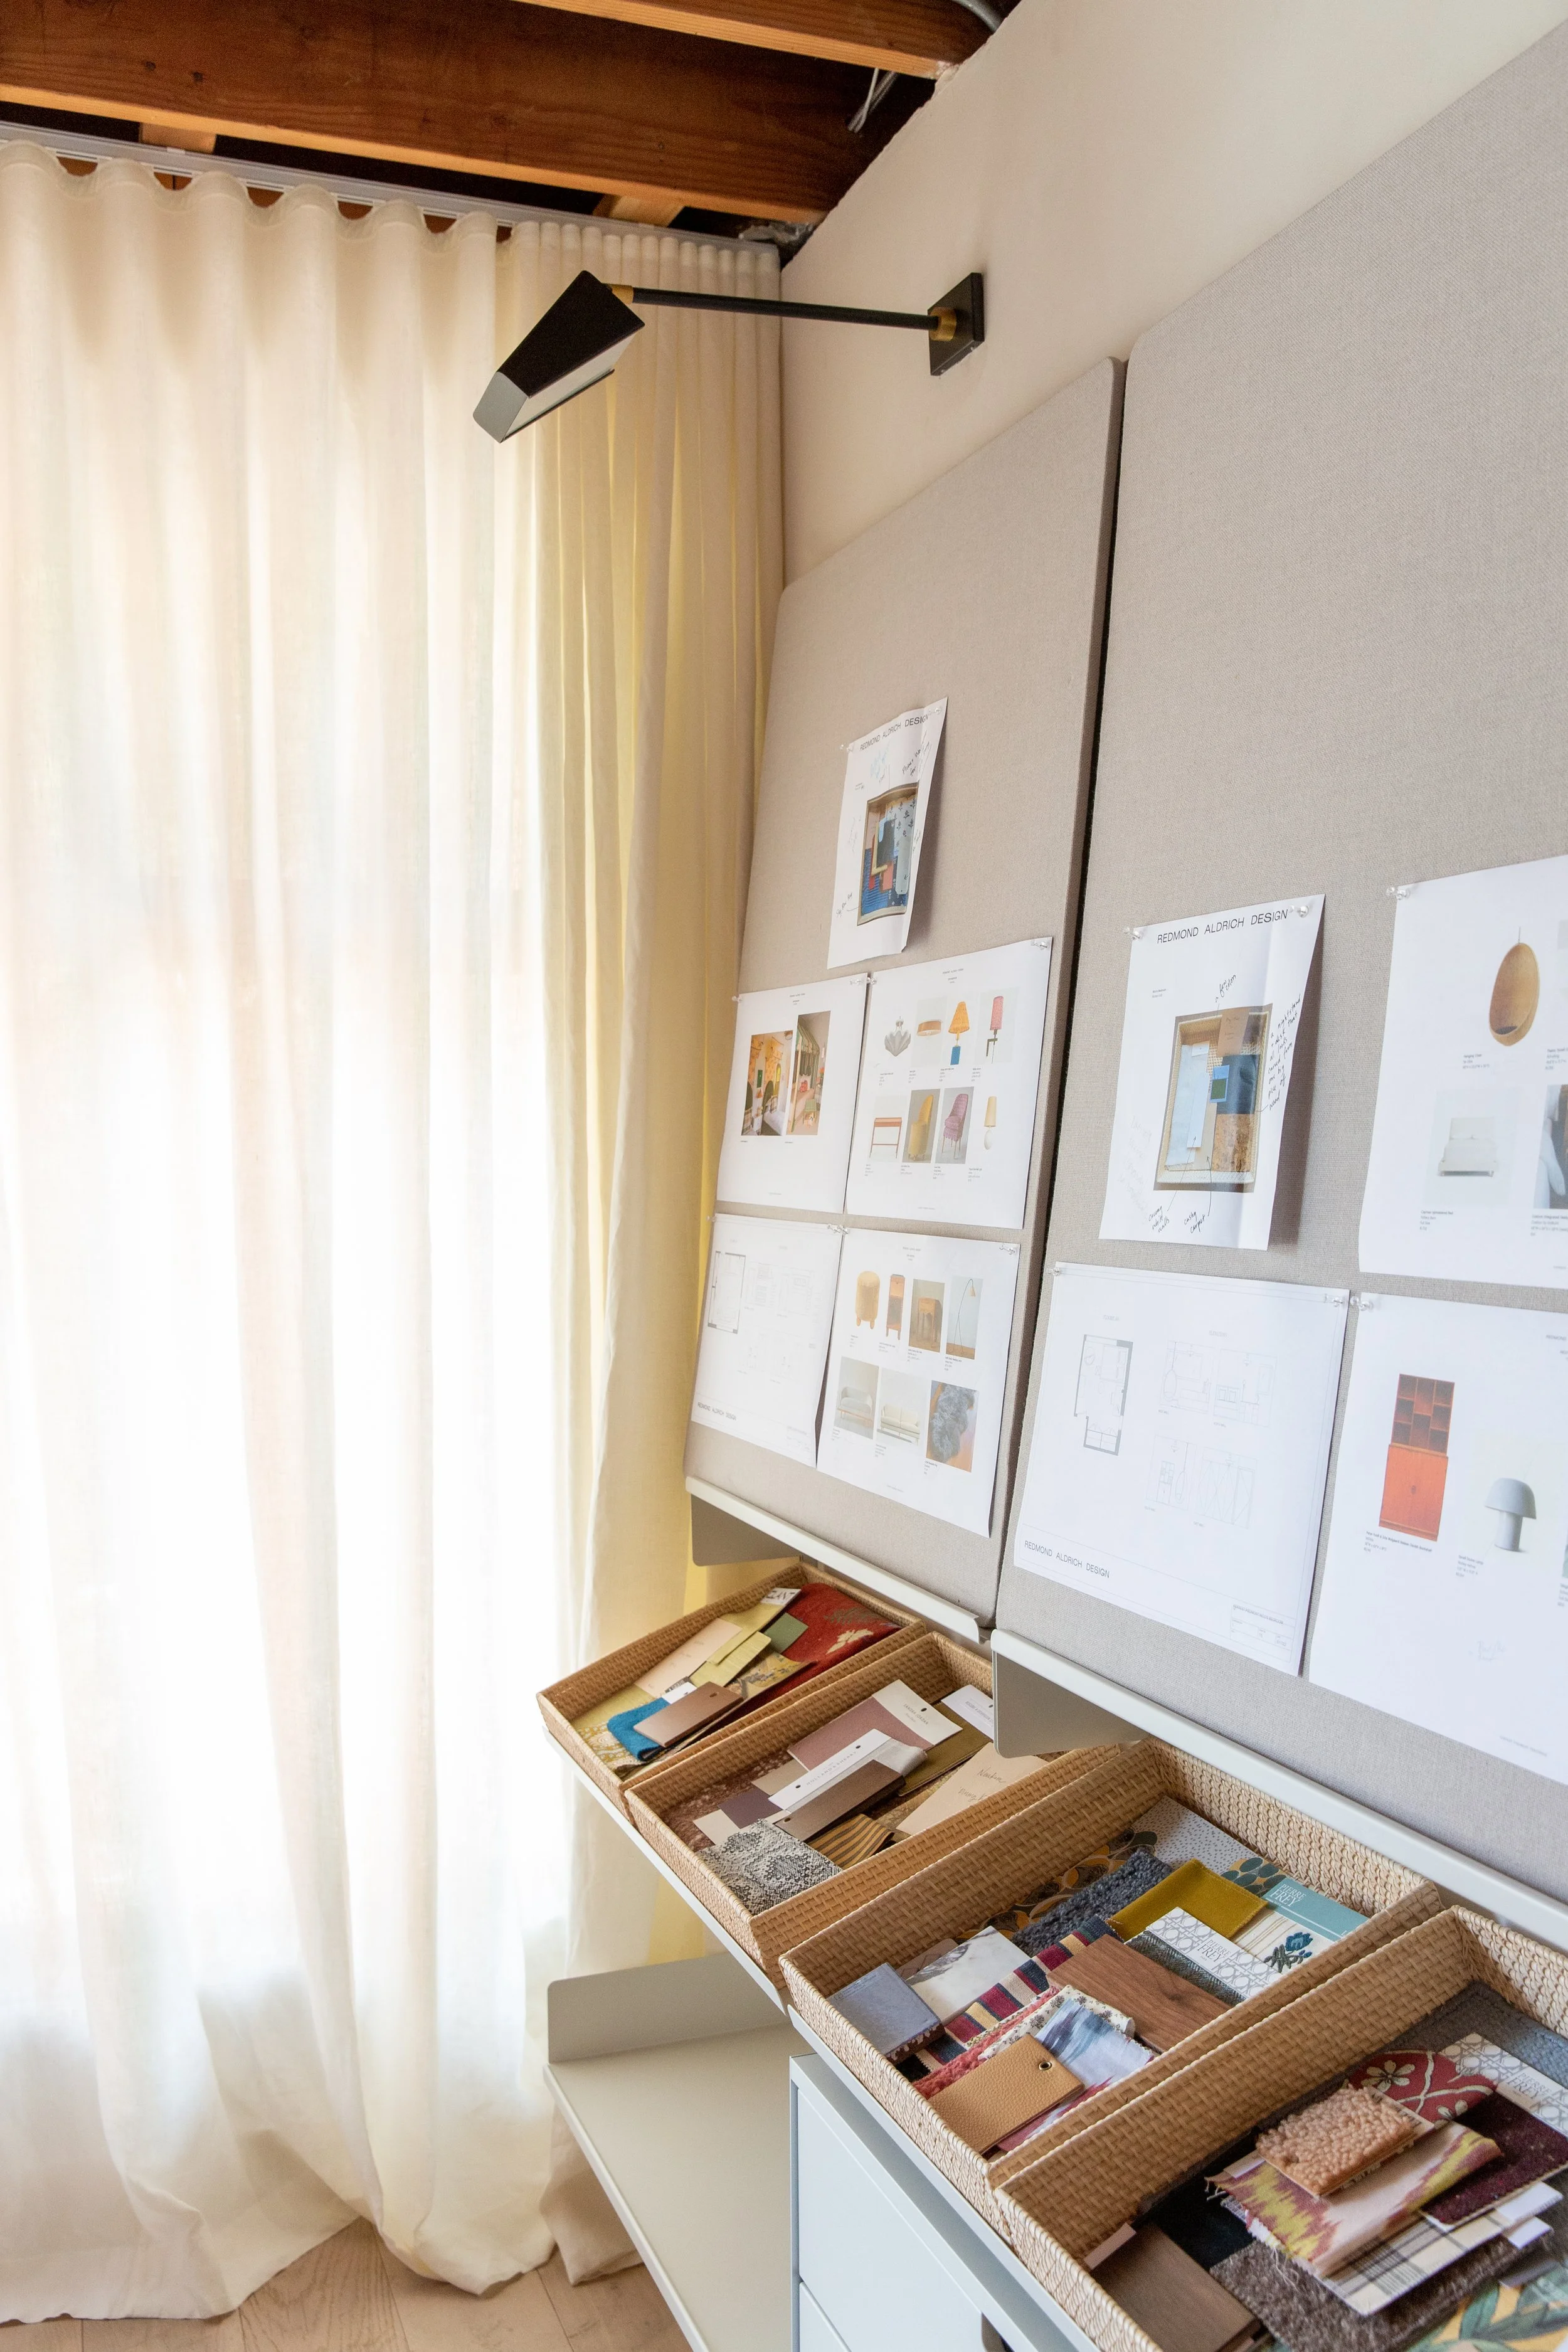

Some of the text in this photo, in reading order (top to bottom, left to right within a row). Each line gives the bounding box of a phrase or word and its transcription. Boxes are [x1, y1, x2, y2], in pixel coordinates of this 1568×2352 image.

[859, 714, 928, 751] REDMOND ALDRICH DESIGN
[1157, 909, 1288, 944] REDMOND ALDRICH DESIGN
[1219, 979, 1227, 998] few
[1283, 1042, 1293, 1059] from
[1279, 1073, 1286, 1088] of
[1190, 1214, 1205, 1234] carpet
[1024, 1540, 1110, 1578] REDMOND ALDRICH DESIGN
[1269, 1889, 1301, 1907] FREY
[1279, 1883, 1306, 1899] PIERRE
[1197, 1944, 1224, 1962] FREY
[1206, 1939, 1232, 1956] PIERRE
[1507, 2077, 1540, 2099] FREY
[1518, 2073, 1552, 2094] PIERRE
